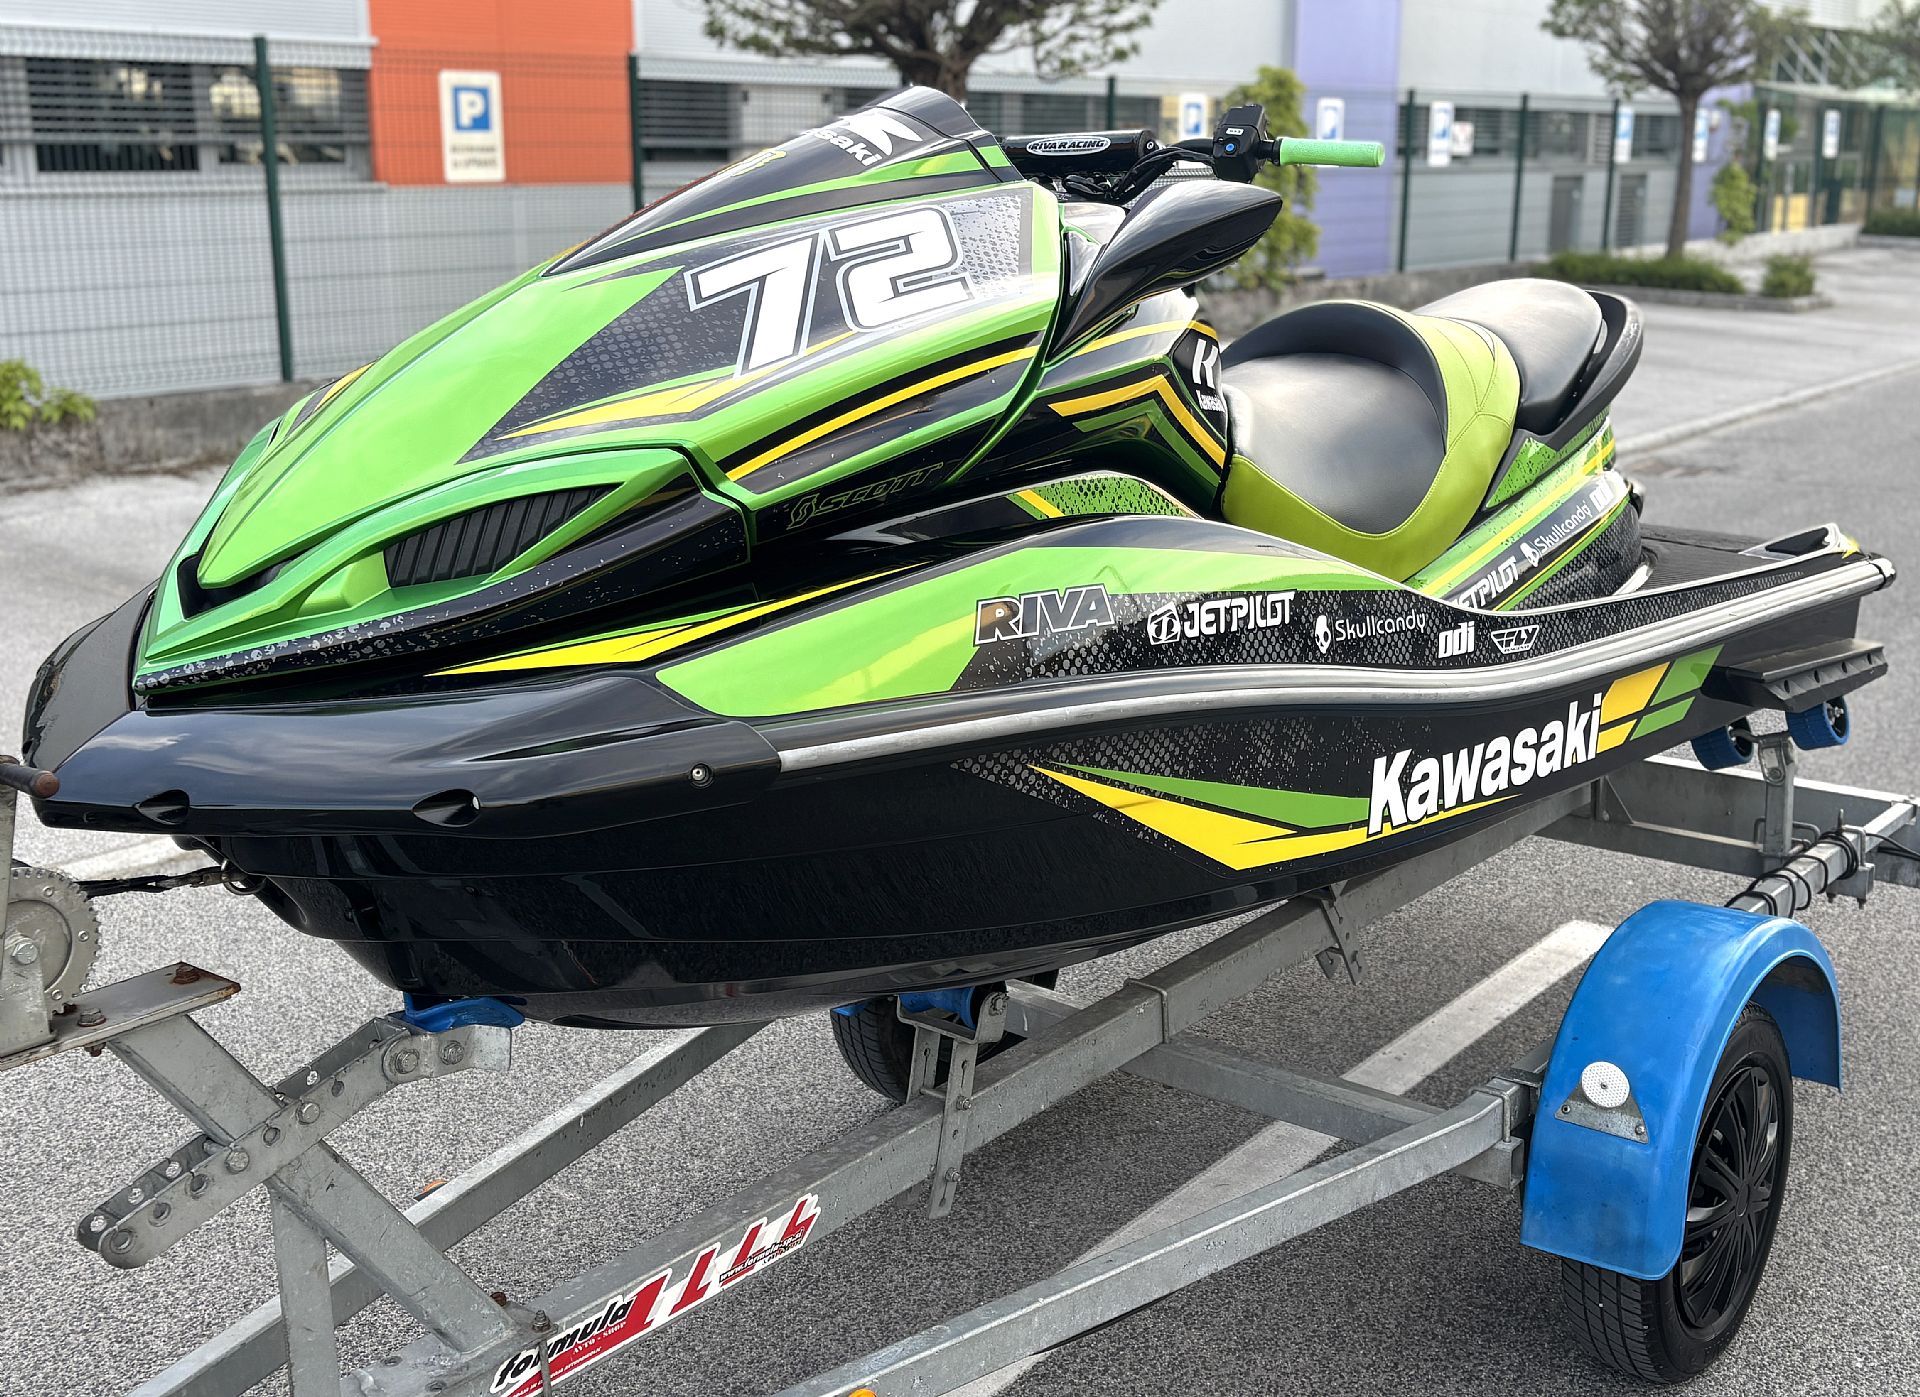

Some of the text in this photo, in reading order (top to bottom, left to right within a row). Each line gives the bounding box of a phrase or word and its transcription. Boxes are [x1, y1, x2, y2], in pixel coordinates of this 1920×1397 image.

[459, 91, 485, 127] P
[1028, 142, 1057, 151] RIVA
[1058, 140, 1106, 149] RACING
[684, 205, 975, 379] 72
[1192, 338, 1219, 389] K
[814, 462, 944, 516] SCOTT
[1534, 501, 1592, 552] Skullcandy
[974, 583, 1115, 646] RIVA
[1183, 591, 1295, 639] JETPILOT
[1335, 609, 1426, 641] Skullcandy
[1495, 627, 1538, 649] FLY
[1438, 621, 1475, 658] odi
[1367, 692, 1603, 836] Kawasaki
